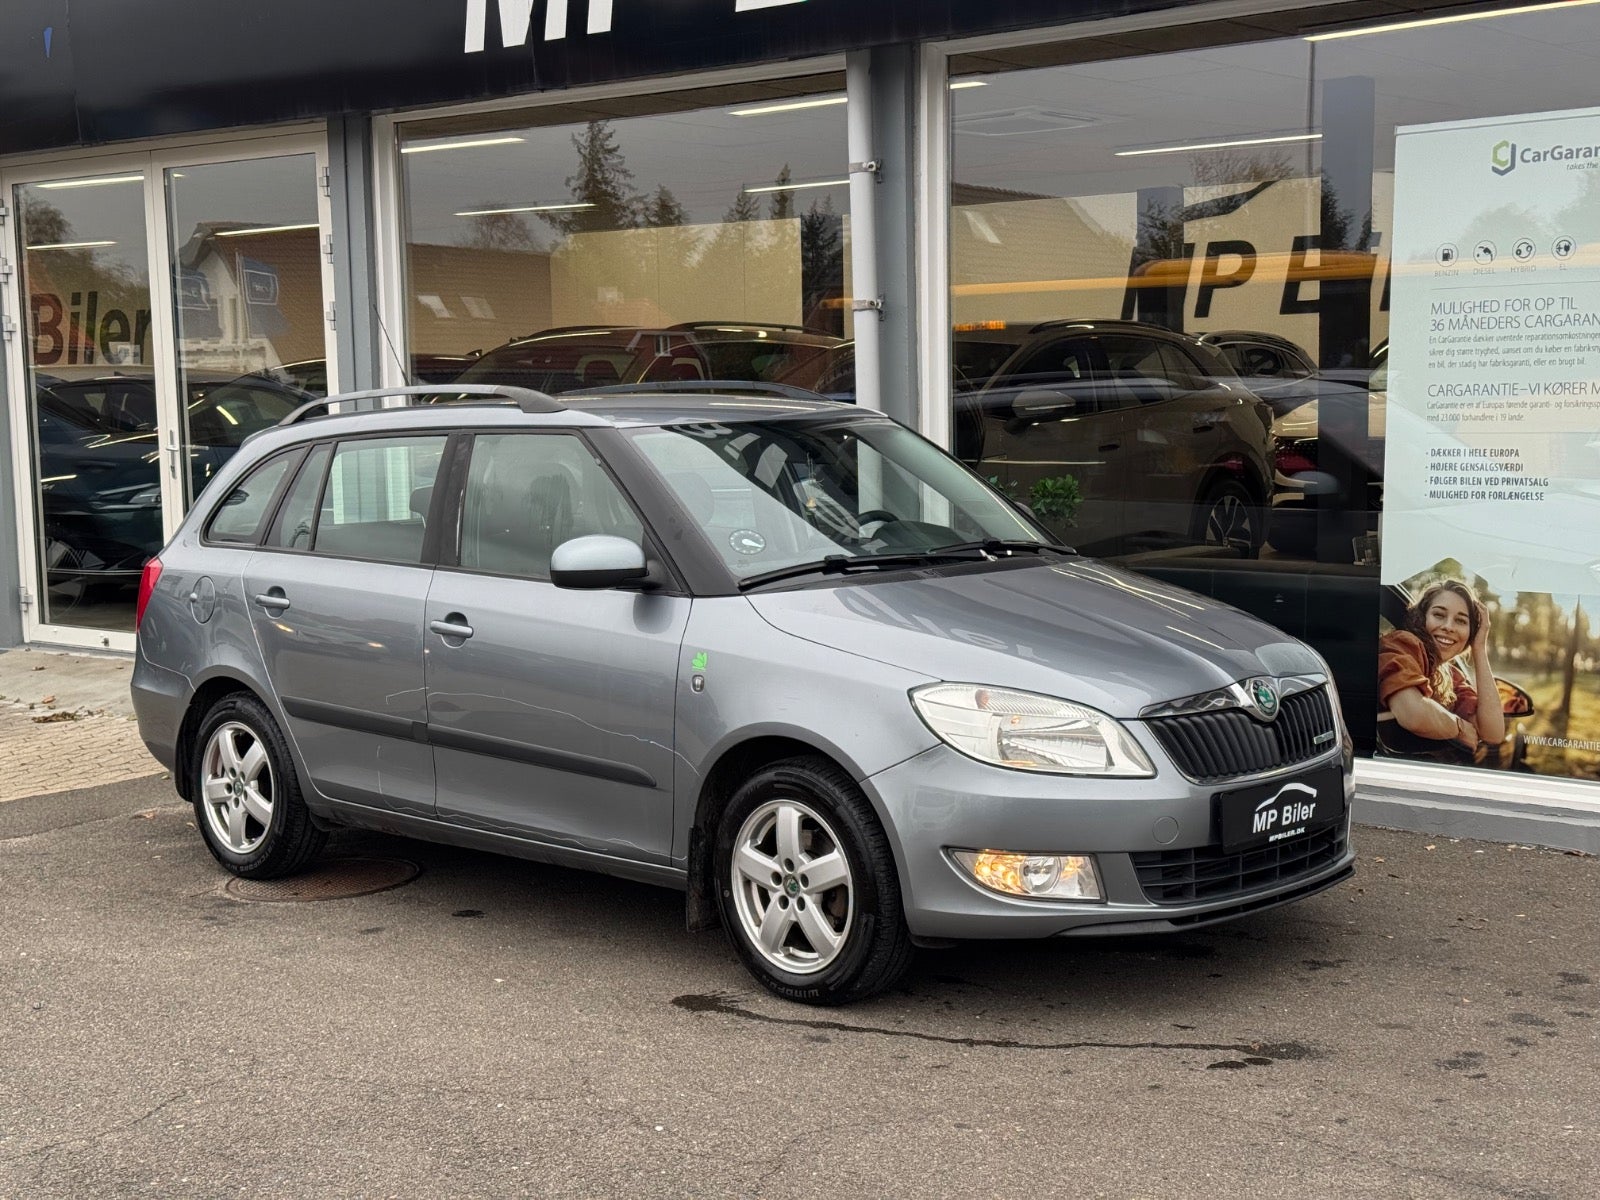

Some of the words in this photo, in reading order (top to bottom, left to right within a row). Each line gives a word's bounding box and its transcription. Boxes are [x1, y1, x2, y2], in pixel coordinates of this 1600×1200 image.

[1434, 269, 1459, 277] BENZIN
[1473, 267, 1495, 275] DIESEL
[1510, 265, 1536, 273] HYBRID
[1430, 300, 1500, 315] MULIGHED
[1504, 298, 1530, 312] FOR
[1534, 297, 1555, 311] OP
[1559, 296, 1578, 310] TIL
[30, 290, 152, 365] Biler
[1430, 318, 1445, 331] 36
[1448, 315, 1521, 331] MÅNEDERS
[1558, 357, 1575, 367] brugt
[1544, 382, 1588, 396] KØRER
[1430, 448, 1461, 458] DÆKKER
[1469, 448, 1487, 458] HELE
[1489, 448, 1520, 458] EUROPA
[1430, 462, 1457, 472] HØJERE
[1460, 462, 1524, 472] GENSALGSVÆRDI
[1429, 475, 1458, 486] FØLGER
[1460, 476, 1482, 486] BILEN
[1484, 476, 1500, 486] VED
[1501, 476, 1549, 487] PRIVATSALG
[1429, 490, 1469, 500] MULIGHED
[1470, 490, 1486, 500] FOR
[1488, 491, 1545, 501] FORLÆNGELSE
[1252, 808, 1278, 834] MP
[1281, 801, 1316, 826] Biler
